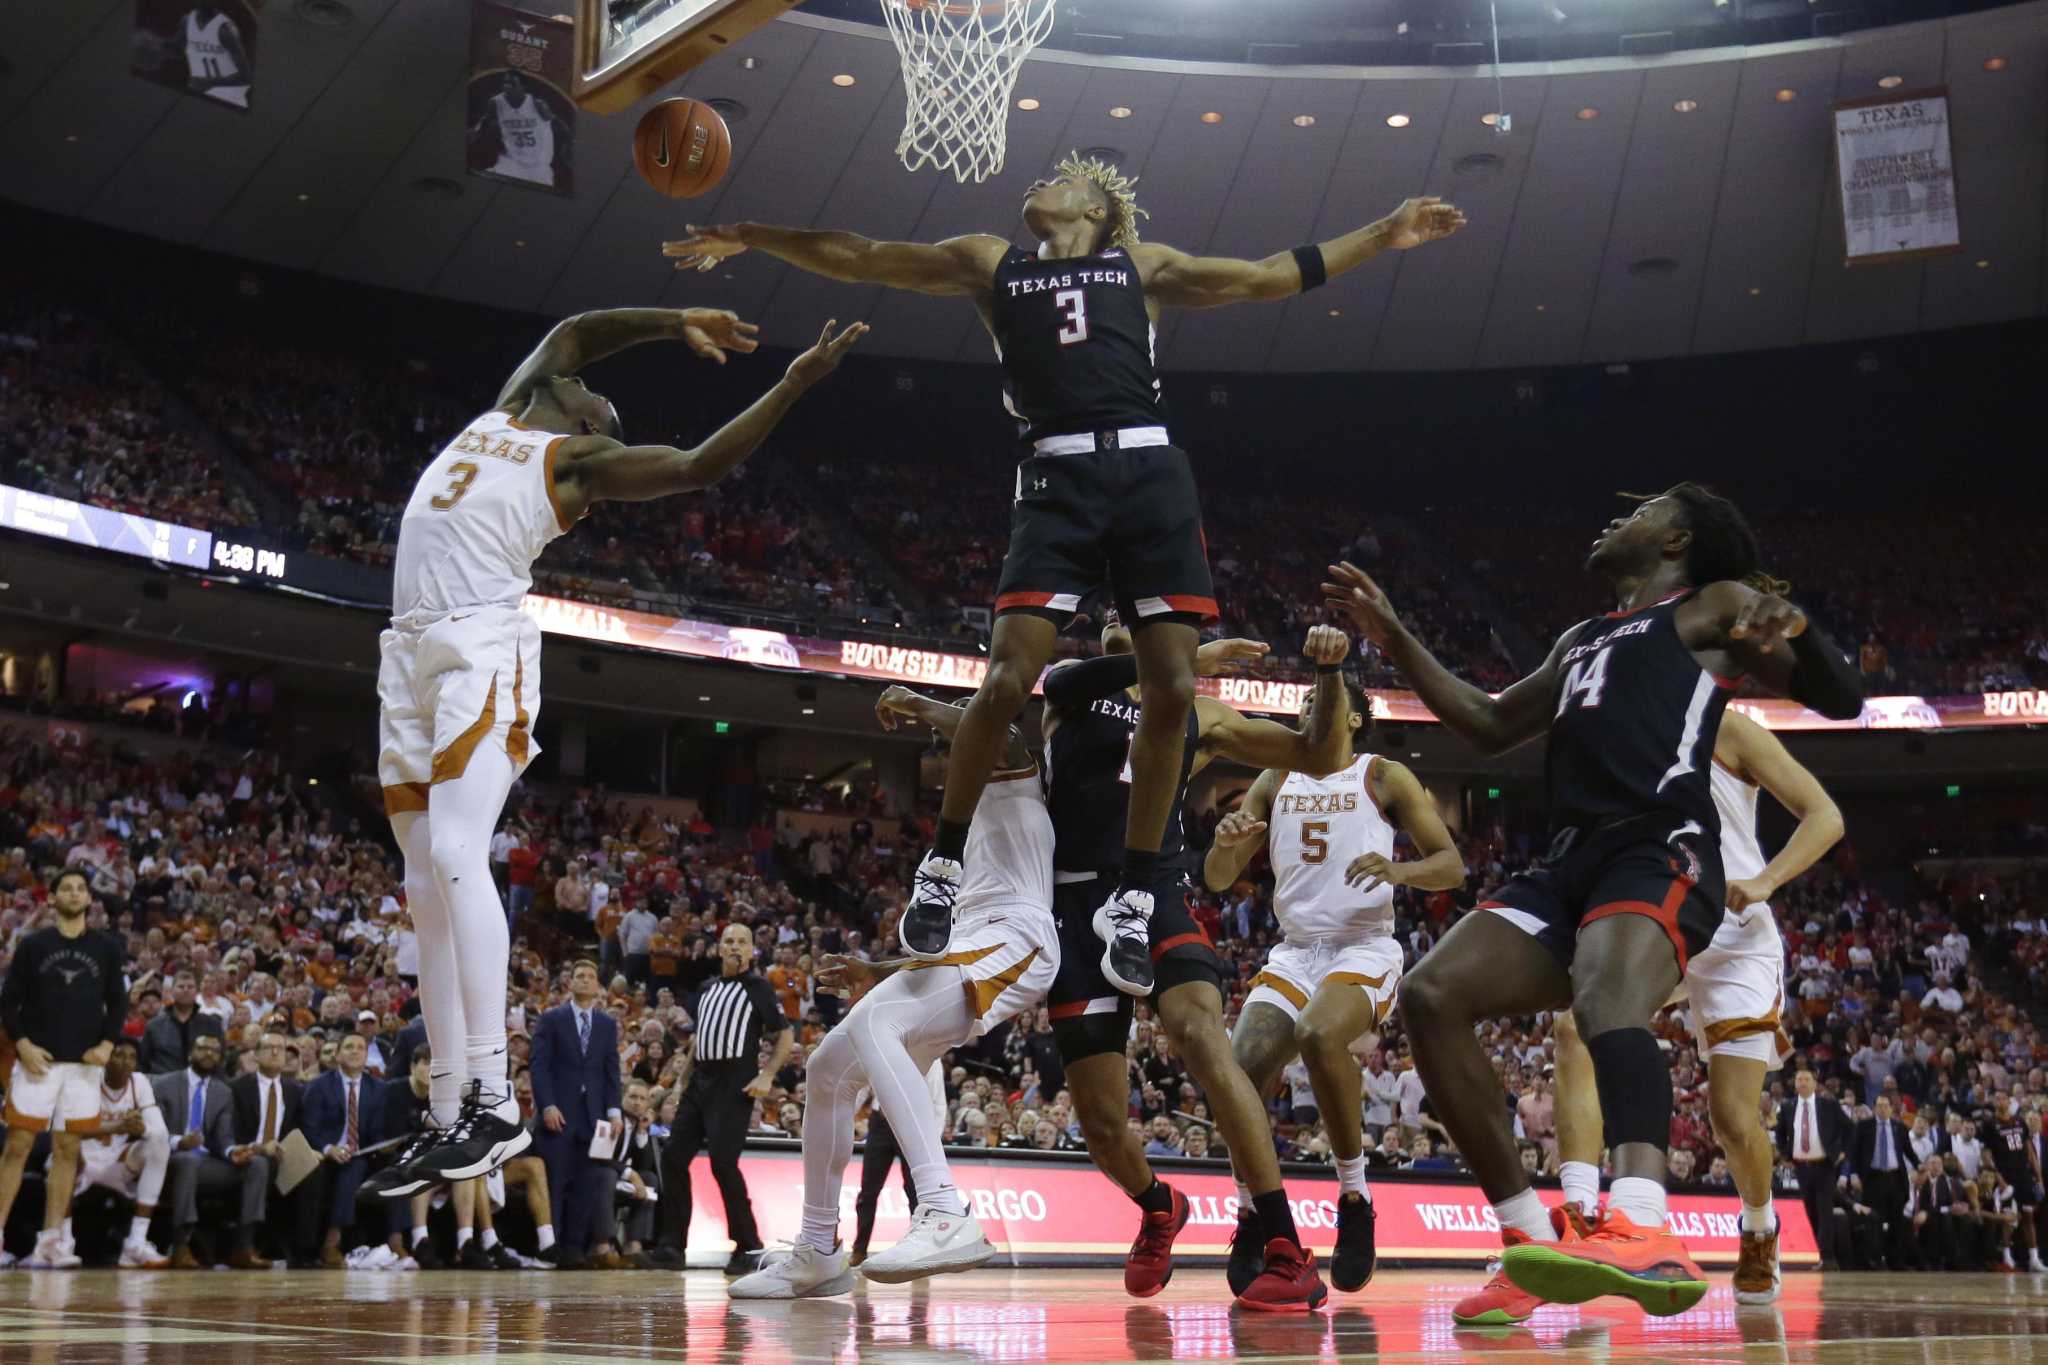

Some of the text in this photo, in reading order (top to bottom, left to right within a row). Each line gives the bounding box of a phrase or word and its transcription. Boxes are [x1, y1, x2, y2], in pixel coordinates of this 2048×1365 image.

[1858, 103, 1924, 125] TEXAS
[510, 131, 537, 148] 35
[1007, 271, 1128, 297] TEXAS TECH
[1056, 289, 1087, 345] 3
[453, 430, 535, 466] EXAS
[431, 458, 479, 511] 3
[256, 549, 285, 578] PM
[1280, 791, 1358, 815] TEXAS
[1300, 821, 1329, 865] 5
[1186, 1196, 1338, 1229] ELLS RGO
[1415, 1203, 1500, 1232] WELLS
